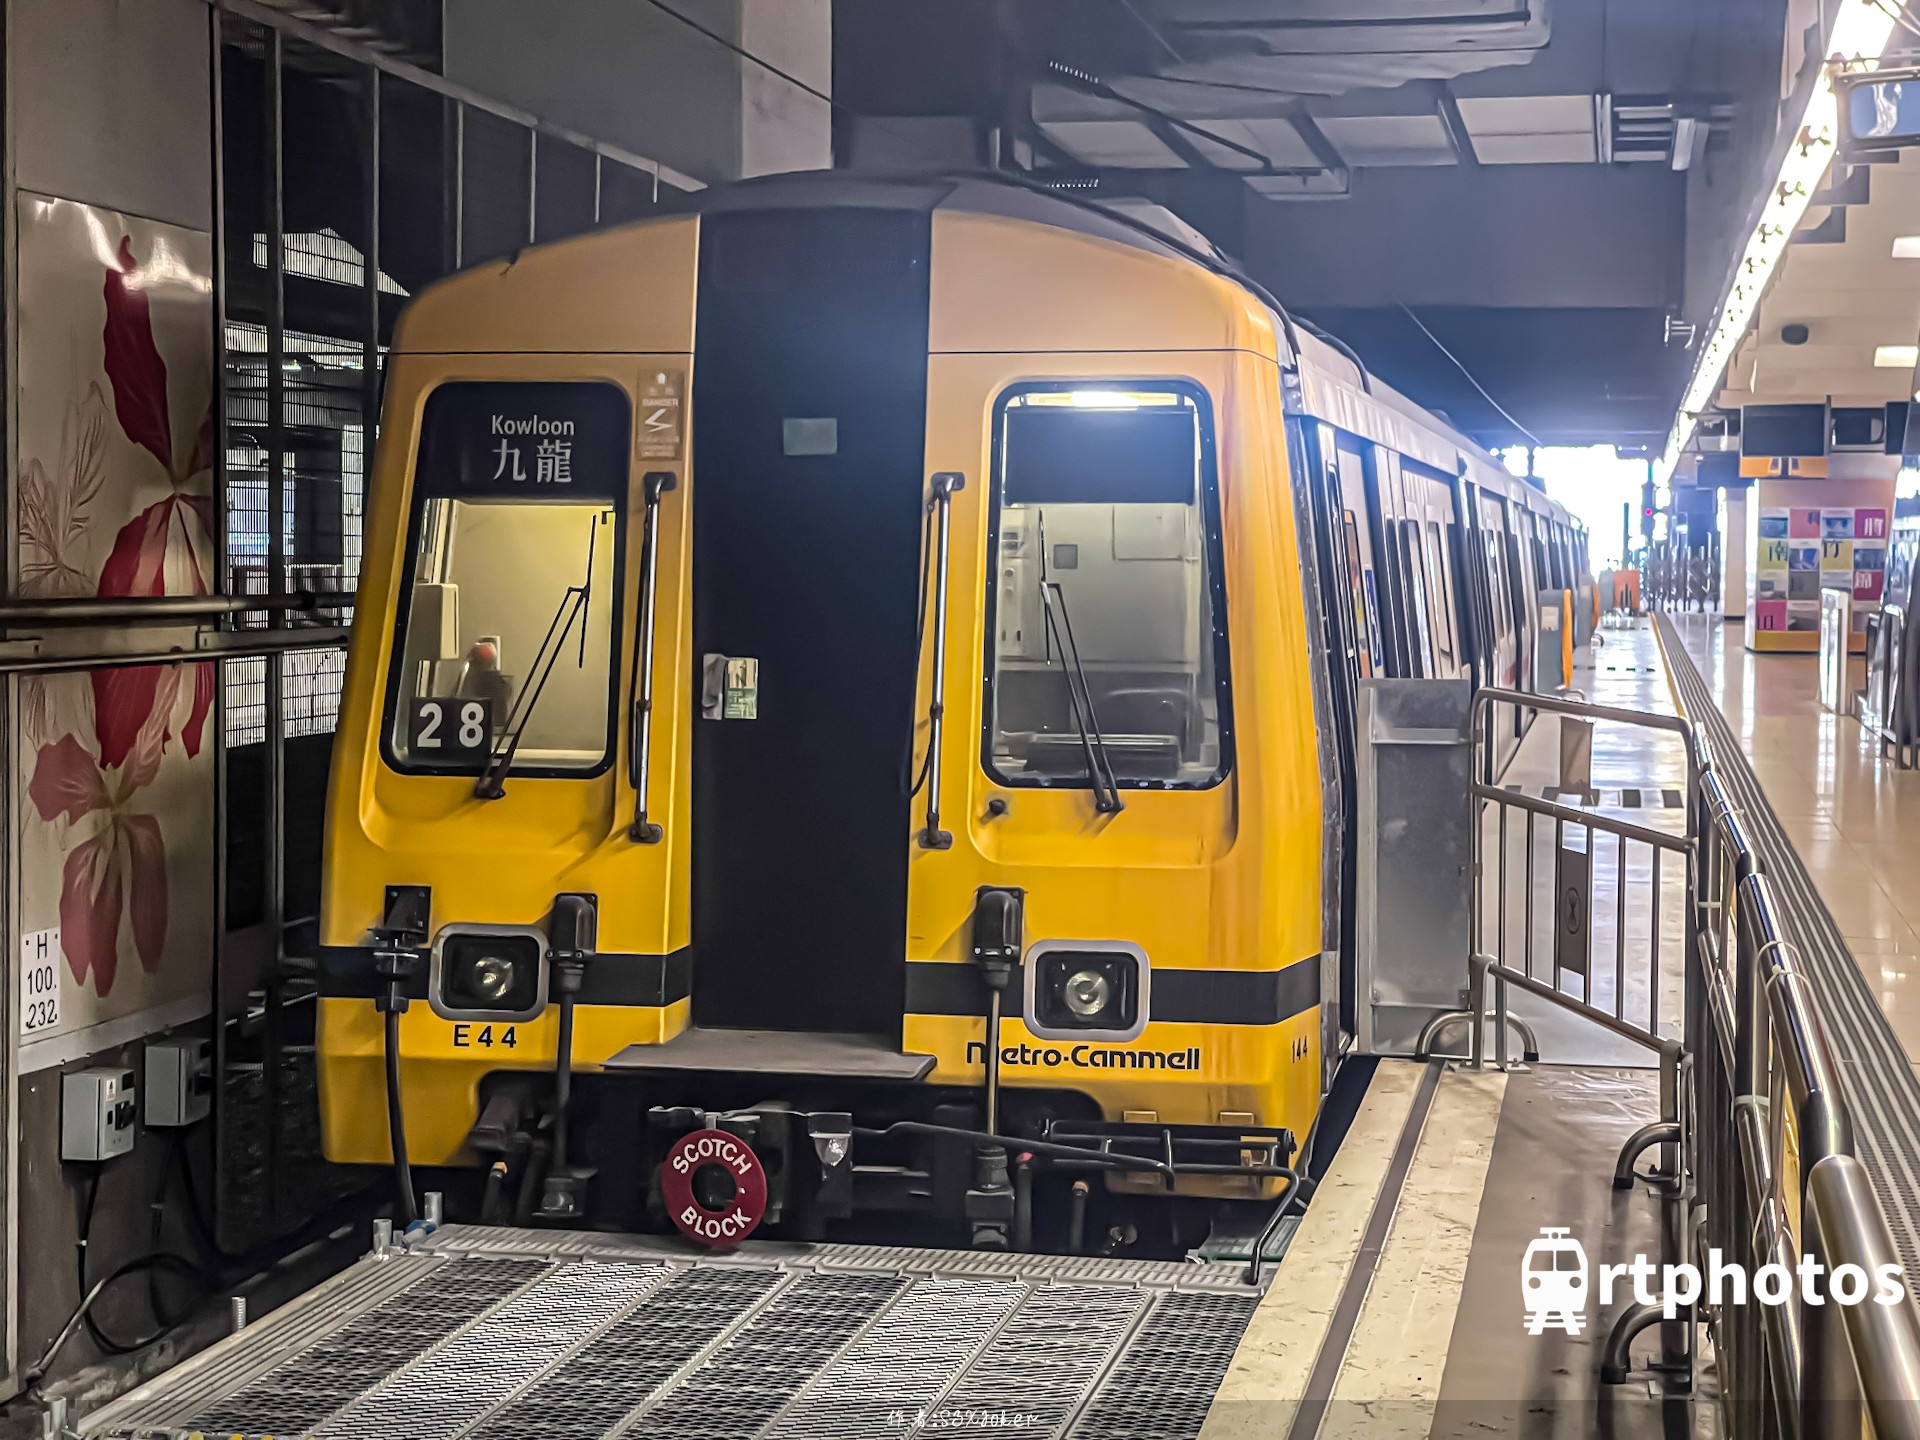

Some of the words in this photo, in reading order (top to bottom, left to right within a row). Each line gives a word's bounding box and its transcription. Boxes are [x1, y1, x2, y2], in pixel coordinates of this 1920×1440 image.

[491, 414, 575, 436] Kowloon
[492, 439, 573, 484] 九龍
[37, 932, 48, 960] H
[453, 1024, 517, 1049] E44
[672, 1138, 752, 1175] SCOTCH
[680, 1206, 752, 1239] BLOCK
